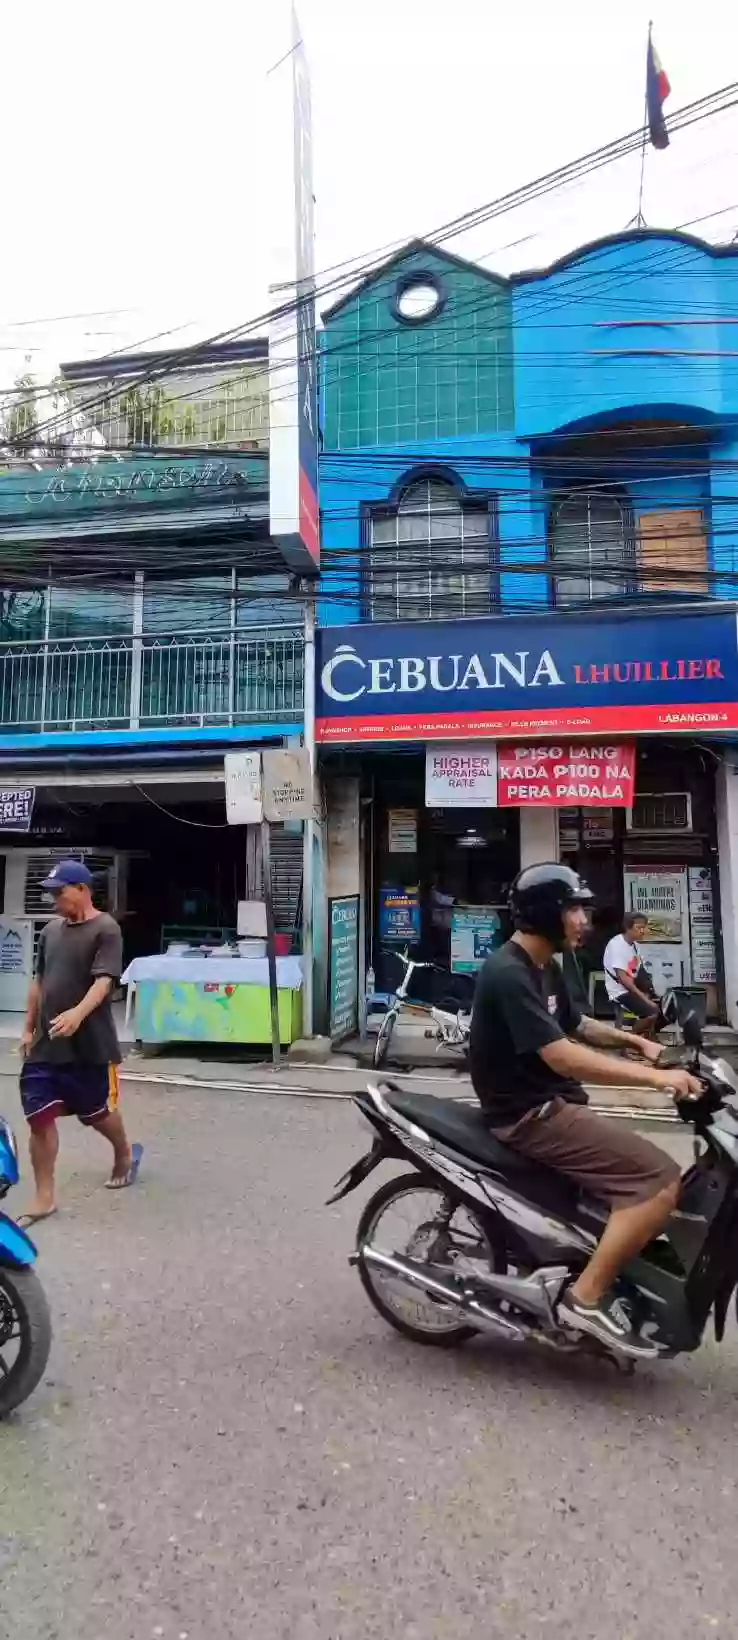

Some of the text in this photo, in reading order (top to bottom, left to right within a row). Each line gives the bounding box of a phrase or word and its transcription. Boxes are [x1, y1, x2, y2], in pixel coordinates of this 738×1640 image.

[321, 644, 725, 702] CEBUANA LHUILLIER
[569, 745, 618, 759] LANG
[433, 757, 490, 769] HIGHER
[432, 768, 492, 778] APPRAISAL
[500, 765, 549, 779] KADA
[605, 764, 632, 779] NA
[449, 778, 477, 788] RATE
[0, 790, 32, 801] EPTED
[508, 784, 624, 799] PERA PADALA
